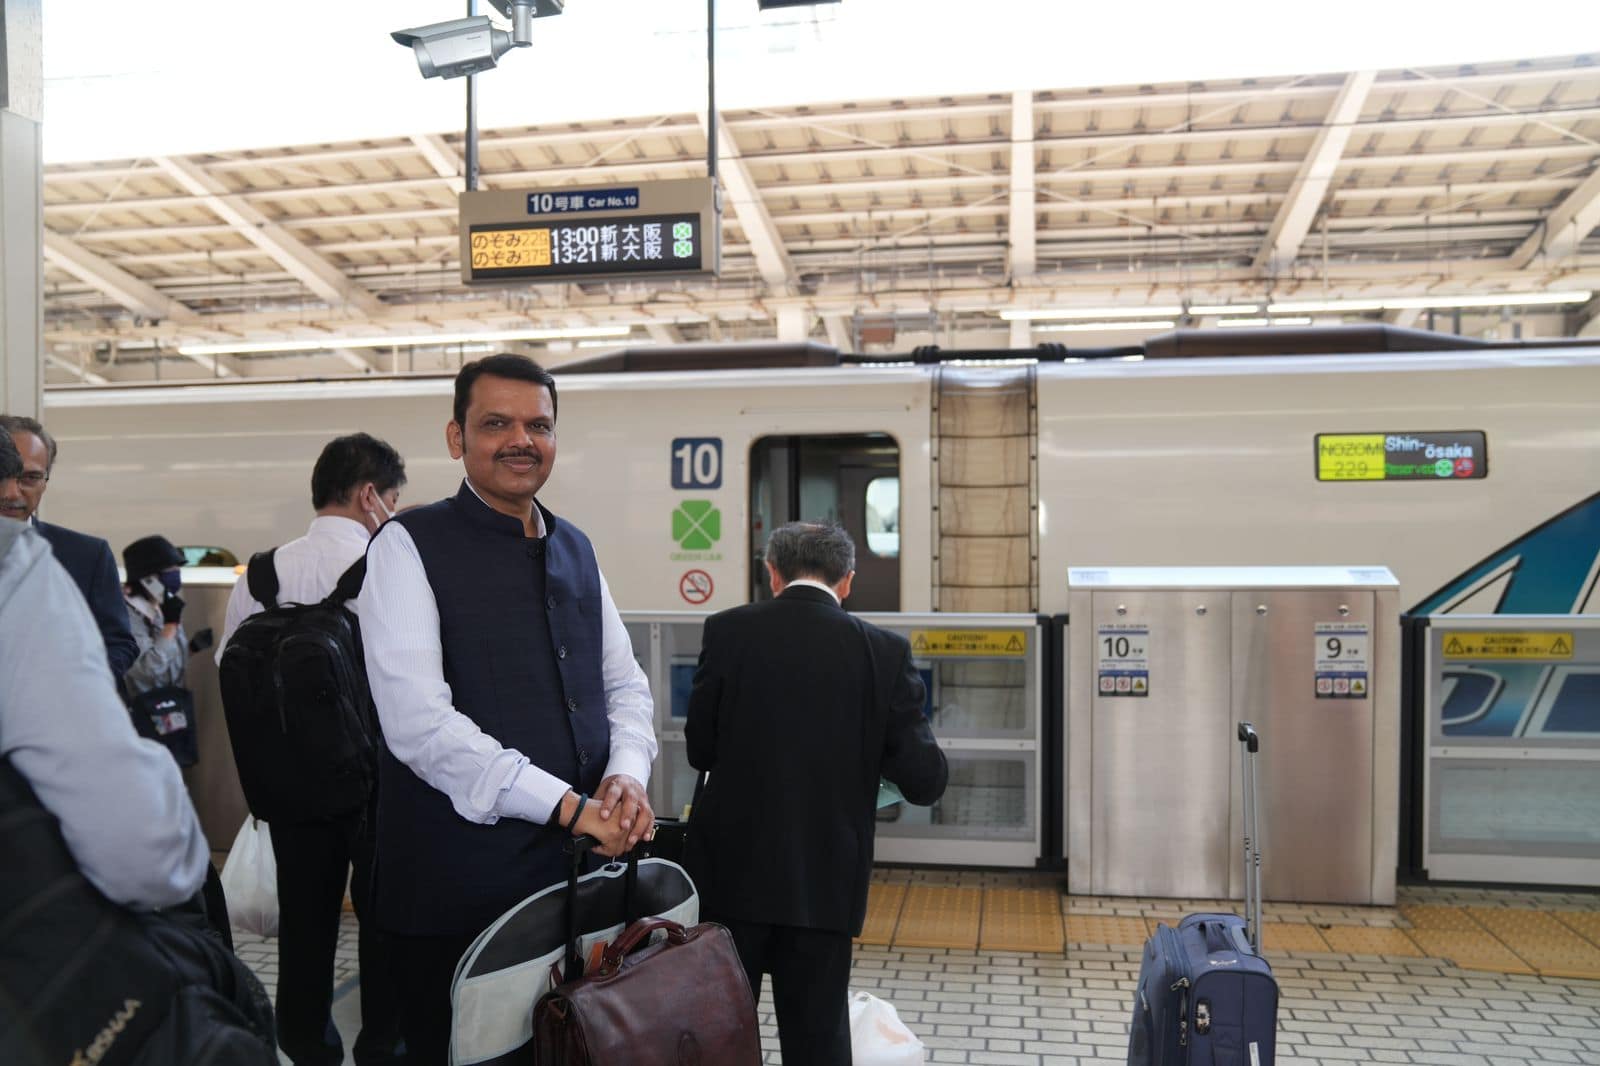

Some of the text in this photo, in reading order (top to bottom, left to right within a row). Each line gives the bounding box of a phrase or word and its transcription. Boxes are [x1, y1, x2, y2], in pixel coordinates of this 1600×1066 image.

[588, 198, 605, 208] Car
[551, 226, 599, 246] 13:00
[600, 224, 662, 243] 新大阪
[551, 246, 597, 264] 13:21
[601, 242, 663, 261] 新大阪
[1320, 443, 1384, 457] NOZOMI
[1385, 436, 1425, 452] Shin-
[675, 443, 719, 484] 10
[1334, 462, 1368, 477] 229
[1104, 637, 1129, 657] 10
[1326, 637, 1342, 658] 9
